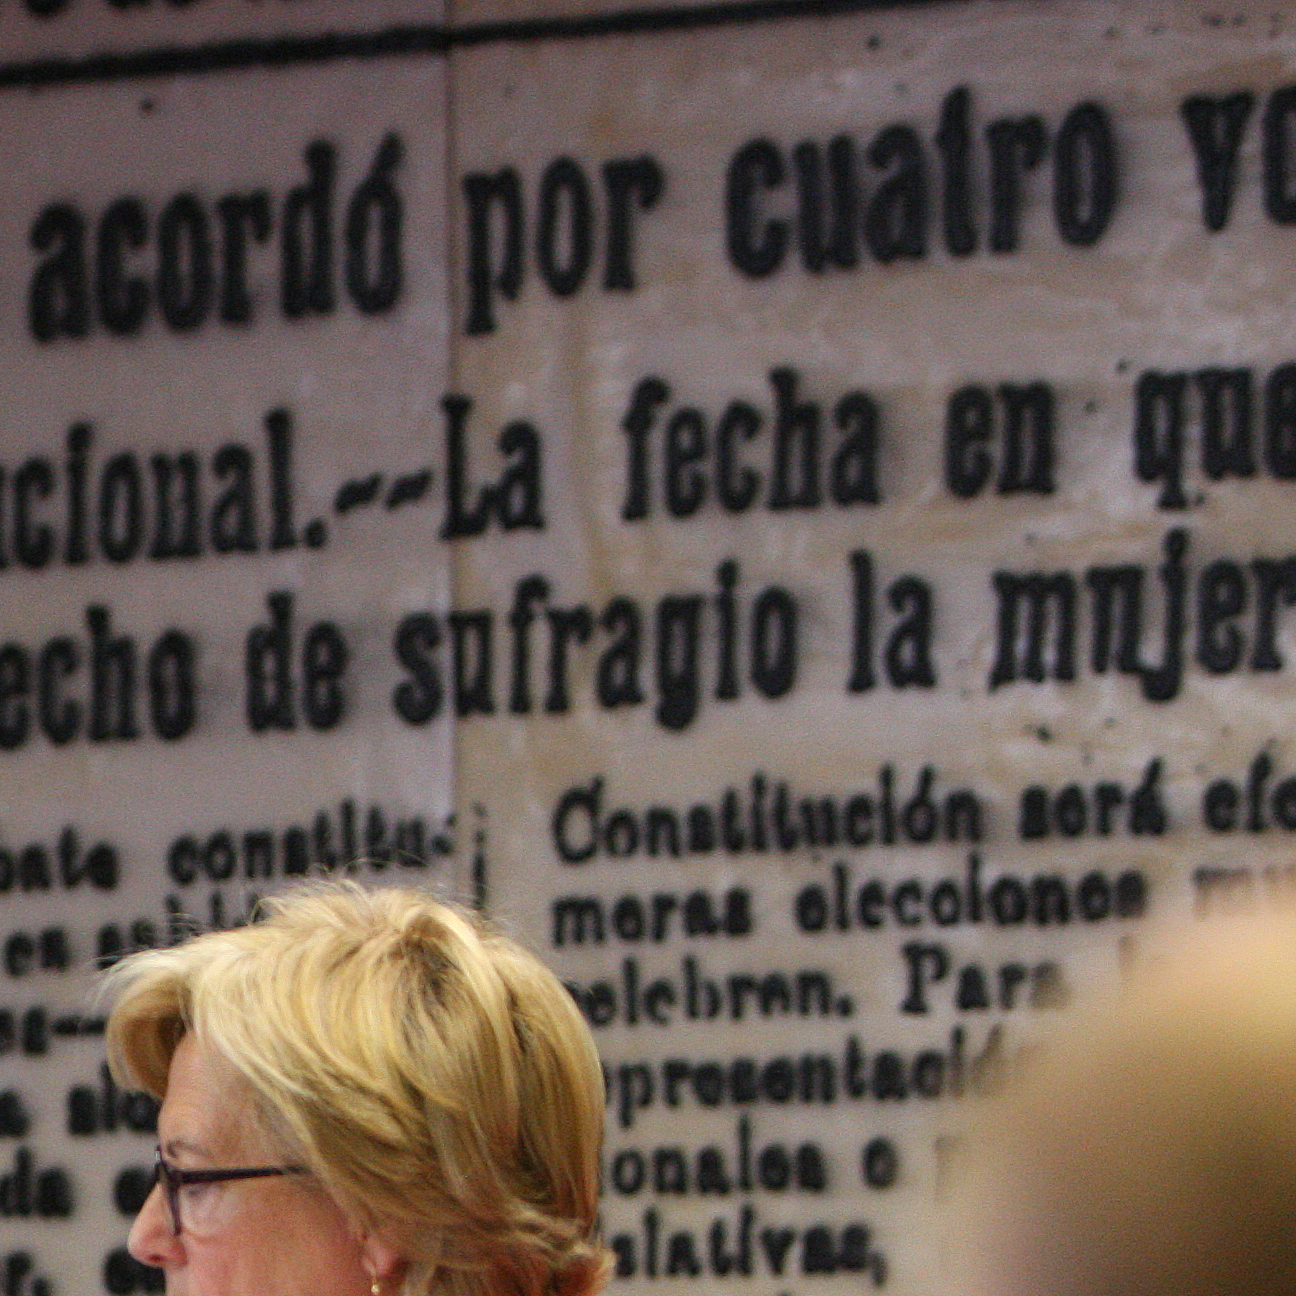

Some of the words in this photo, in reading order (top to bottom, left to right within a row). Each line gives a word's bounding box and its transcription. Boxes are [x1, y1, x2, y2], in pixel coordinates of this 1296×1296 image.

[28, 133, 406, 345] acordó
[463, 155, 666, 335] por
[724, 85, 1118, 278] cuatro
[623, 367, 883, 522] fecha
[943, 383, 1058, 498] en
[243, 590, 351, 733] de
[393, 560, 800, 730] sufragio
[846, 550, 936, 693] la
[551, 760, 985, 865] Constitución
[1020, 755, 1170, 840] será
[551, 885, 753, 947] meras
[794, 855, 1148, 934] elecciones
[568, 953, 853, 1027] elebren.
[606, 1113, 828, 1196] onales
